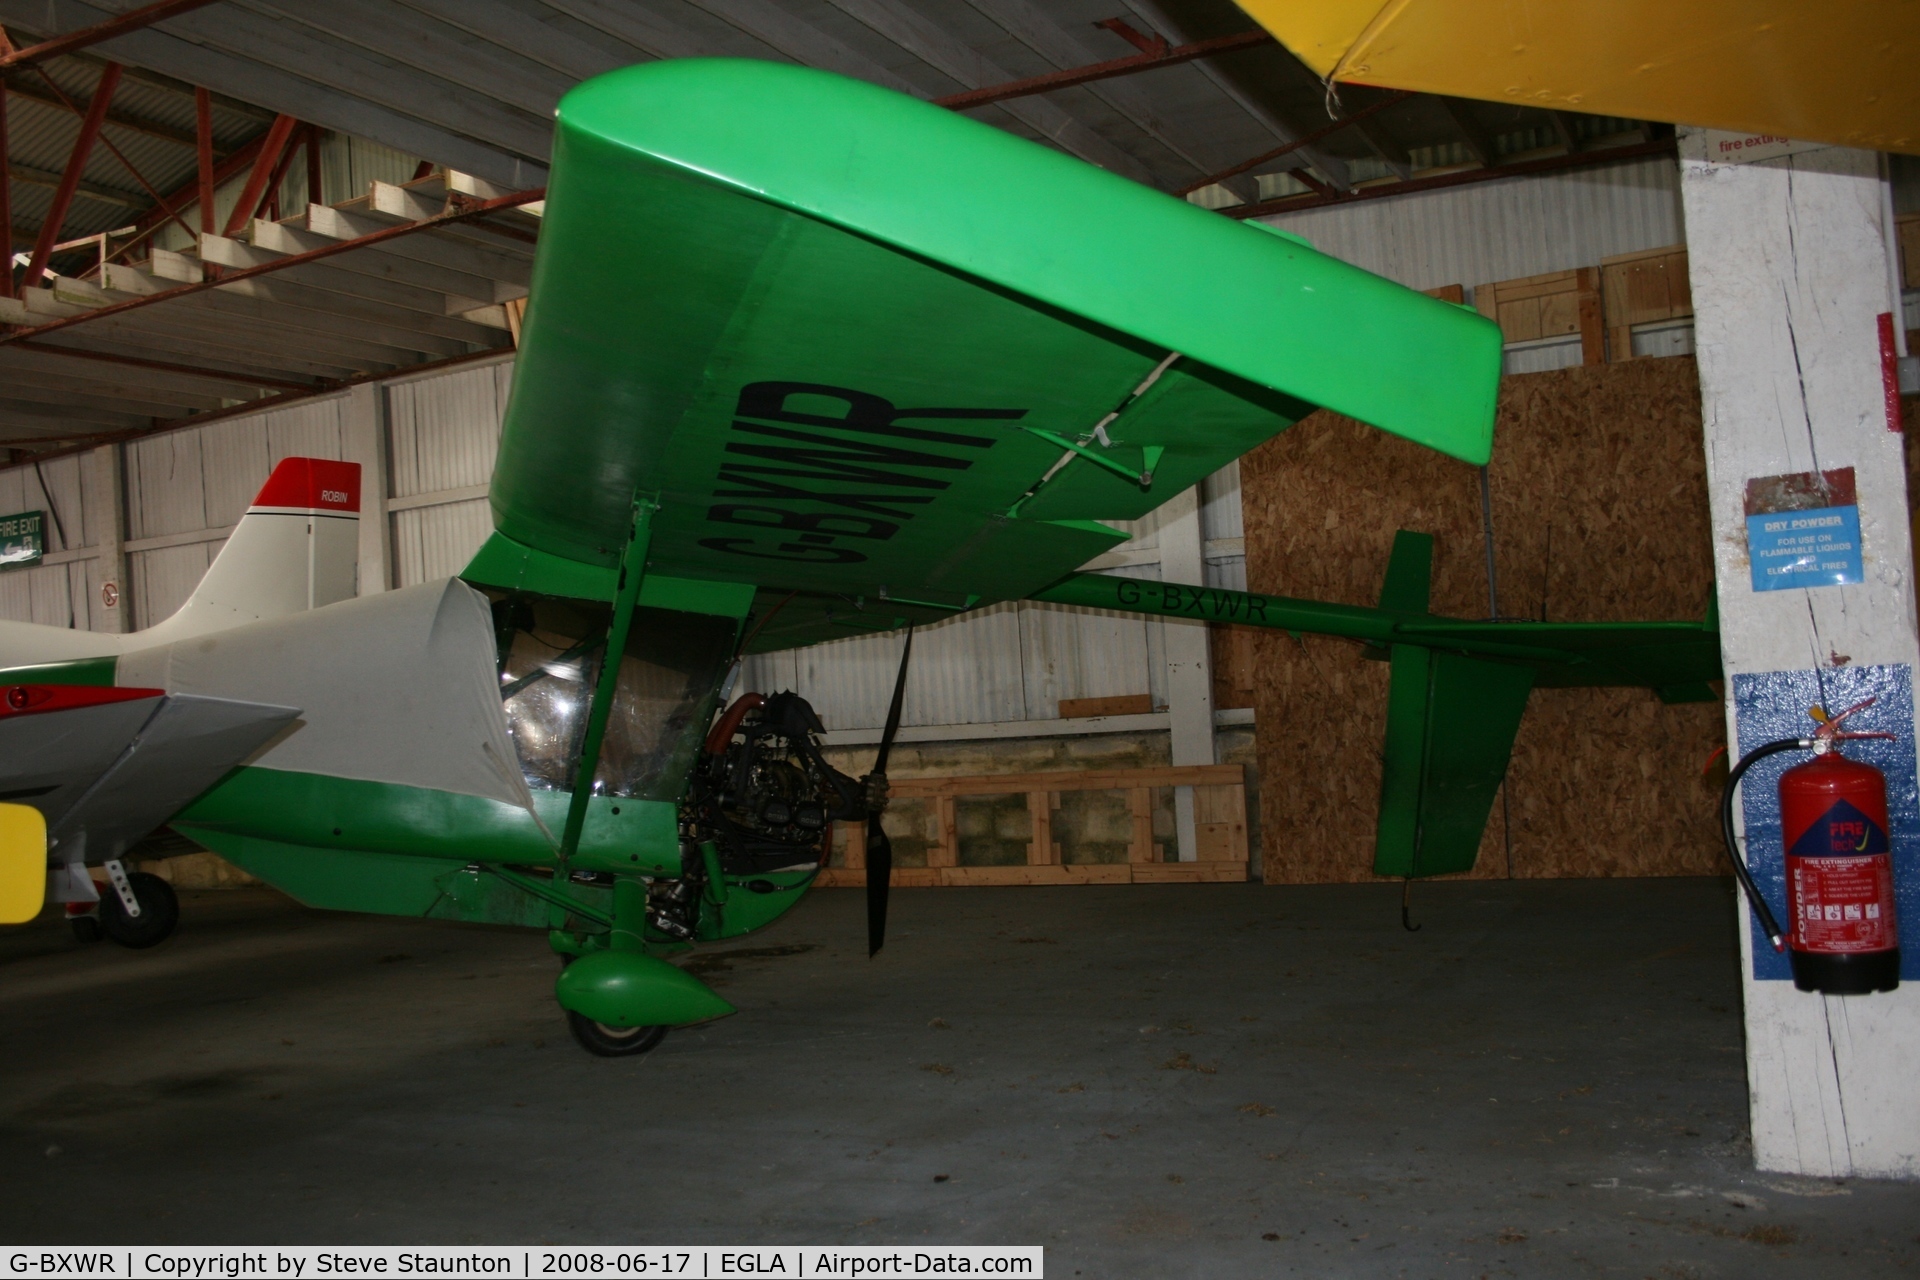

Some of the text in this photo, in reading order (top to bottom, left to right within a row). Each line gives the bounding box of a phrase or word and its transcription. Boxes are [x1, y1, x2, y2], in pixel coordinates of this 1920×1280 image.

[1719, 139, 1742, 153] fire
[697, 380, 1031, 564] G-BXWR
[321, 489, 348, 504] ROBIN
[0, 516, 40, 537] FIRE EXIT
[1764, 515, 1843, 531] DRY POWDER
[1777, 534, 1832, 546] FOR USE ON
[1760, 542, 1851, 557] FLAMMABLE LIQUIDS
[1822, 561, 1848, 571] FIRES
[1117, 579, 1268, 622] G-BXWR
[1829, 821, 1864, 836] FIRE
[1820, 857, 1873, 865] EXTINGUISHER
[1793, 868, 1807, 944] POWDER
